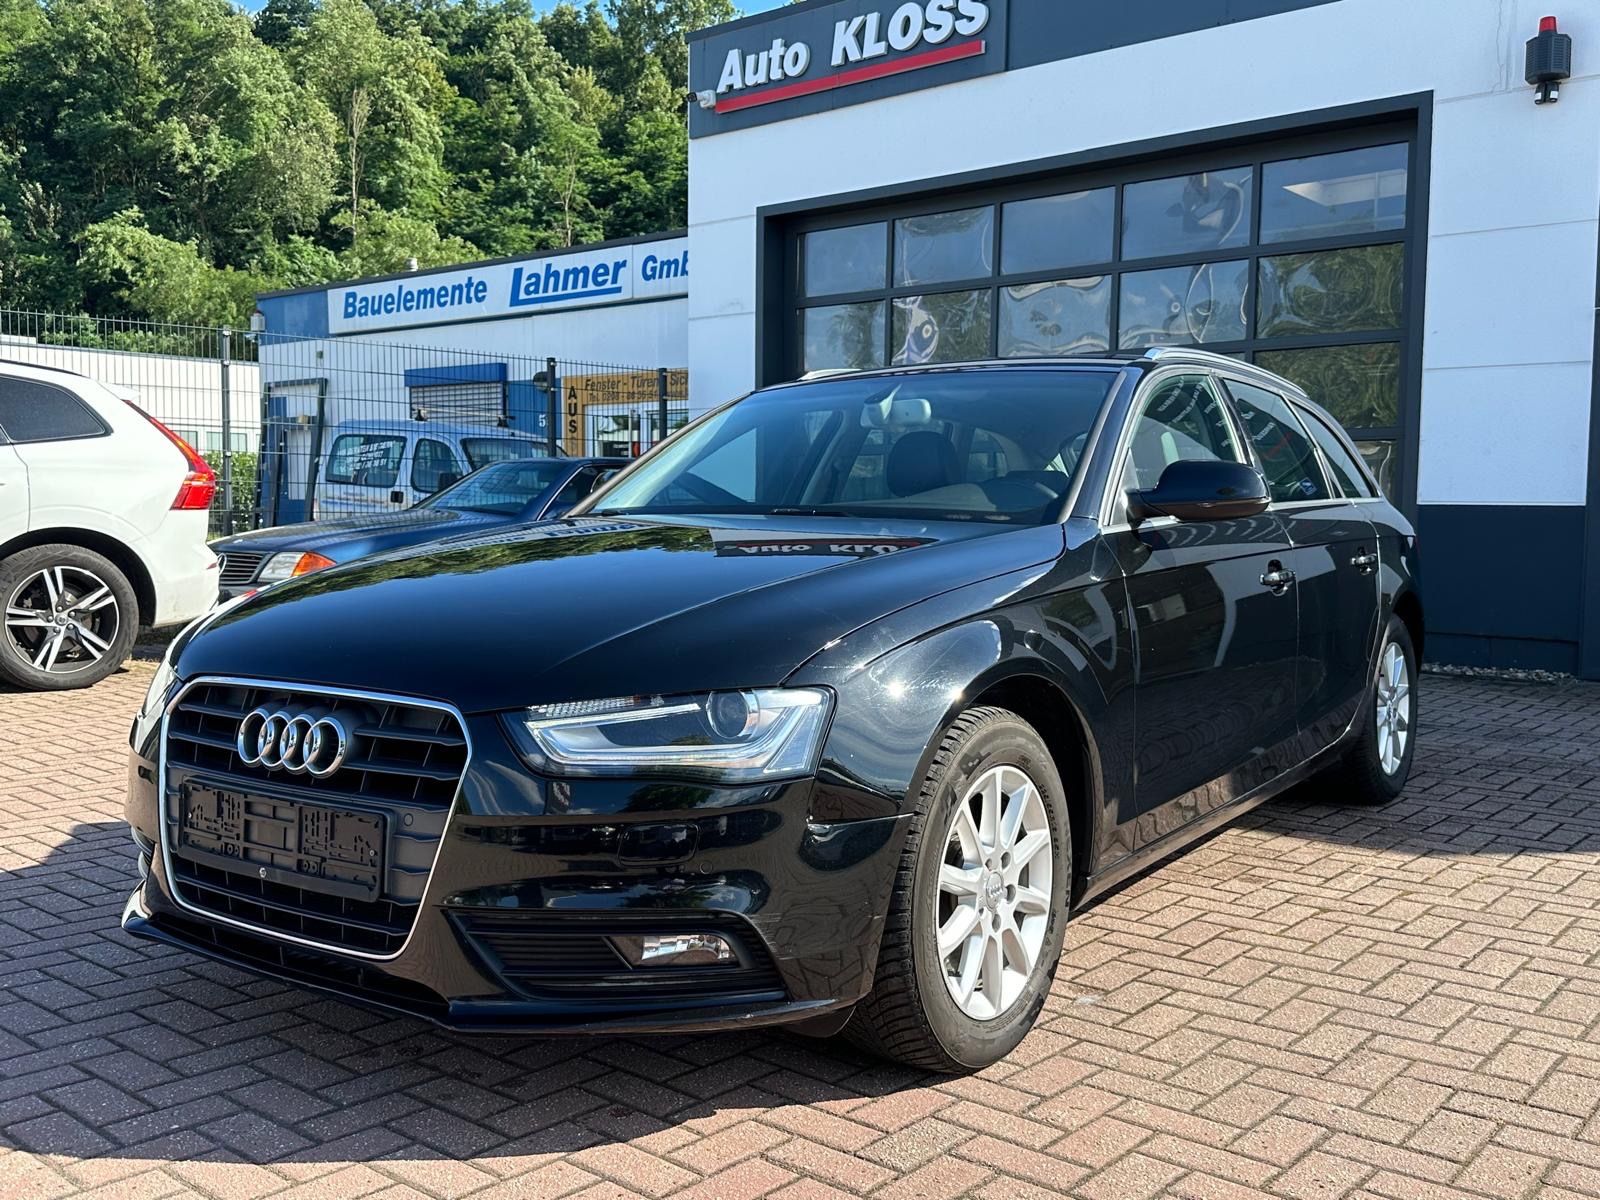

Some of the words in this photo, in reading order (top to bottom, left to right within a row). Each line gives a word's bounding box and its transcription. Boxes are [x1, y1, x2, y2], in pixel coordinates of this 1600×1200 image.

[716, 37, 811, 94] Auto
[831, 0, 990, 67] KLOSS
[343, 276, 488, 319] Bauelemente
[509, 259, 628, 307] Lahmer
